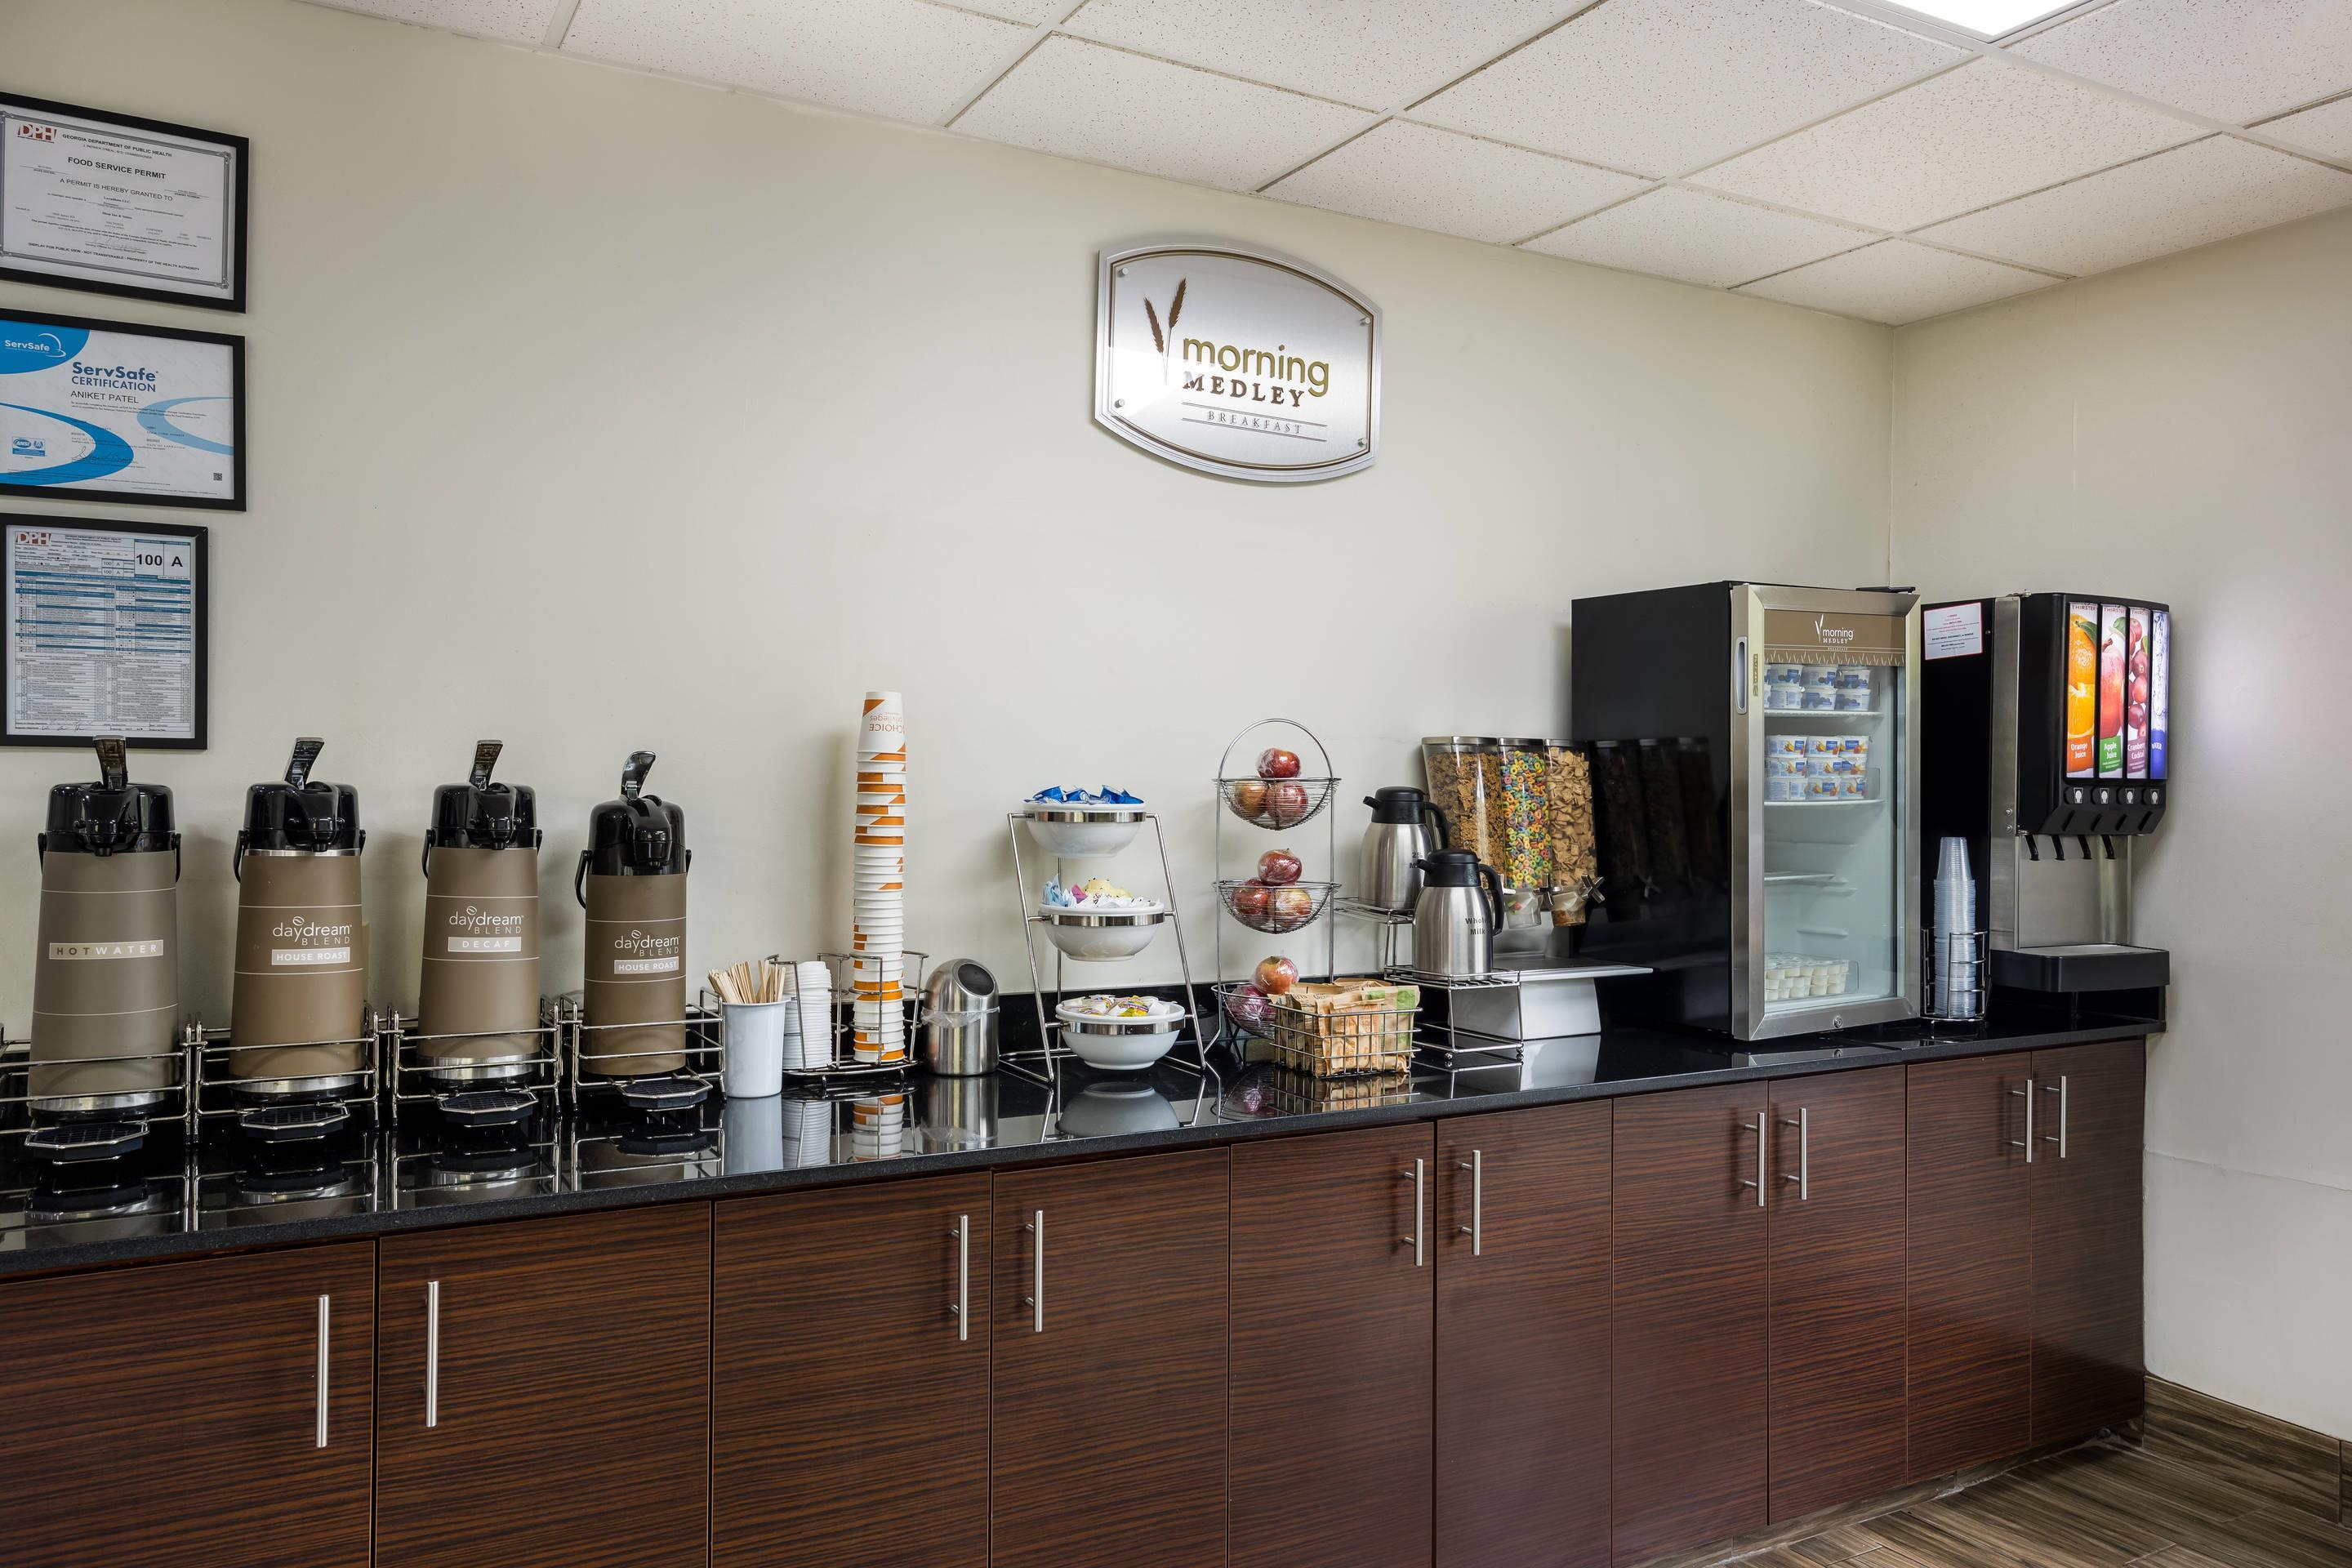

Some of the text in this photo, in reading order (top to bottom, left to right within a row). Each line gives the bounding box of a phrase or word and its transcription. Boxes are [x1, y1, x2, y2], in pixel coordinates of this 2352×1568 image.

[20, 124, 55, 141] DPH
[62, 133, 87, 142] GEORGIA
[88, 138, 123, 149] DEPARTMENT
[132, 146, 151, 154] PUBLIC
[68, 156, 167, 180] FOOD SERVICE PERMIT
[66, 179, 91, 188] PERMIT
[101, 185, 129, 194] HEREBY
[130, 189, 163, 200] GRANTED
[5, 339, 50, 352] ServSafe
[72, 361, 156, 382] ServSafe
[1183, 337, 1330, 398] morning
[71, 376, 156, 392] CERTIFICATION
[1183, 371, 1304, 408] MEDLEY
[70, 390, 139, 403] ANIKET PATEL
[1207, 410, 1303, 434] BREAKFAST
[17, 532, 50, 546] DPH
[136, 554, 184, 568] 100 A
[1822, 627, 1854, 640] morning
[869, 724, 902, 733] CHOICE
[2070, 742, 2088, 751] Orange
[2104, 742, 2118, 751] Apple
[2074, 751, 2087, 759] Juice
[2106, 751, 2118, 760] Juice
[449, 911, 522, 931] daydream
[272, 921, 350, 942] daydream
[474, 926, 522, 934] BLEND
[301, 936, 350, 946] BLEND
[462, 940, 510, 948] DECAF
[614, 934, 679, 954] daydream
[276, 951, 347, 961] HOUSE ROAST
[639, 947, 679, 956] BLEND
[653, 961, 676, 969] ROAST
